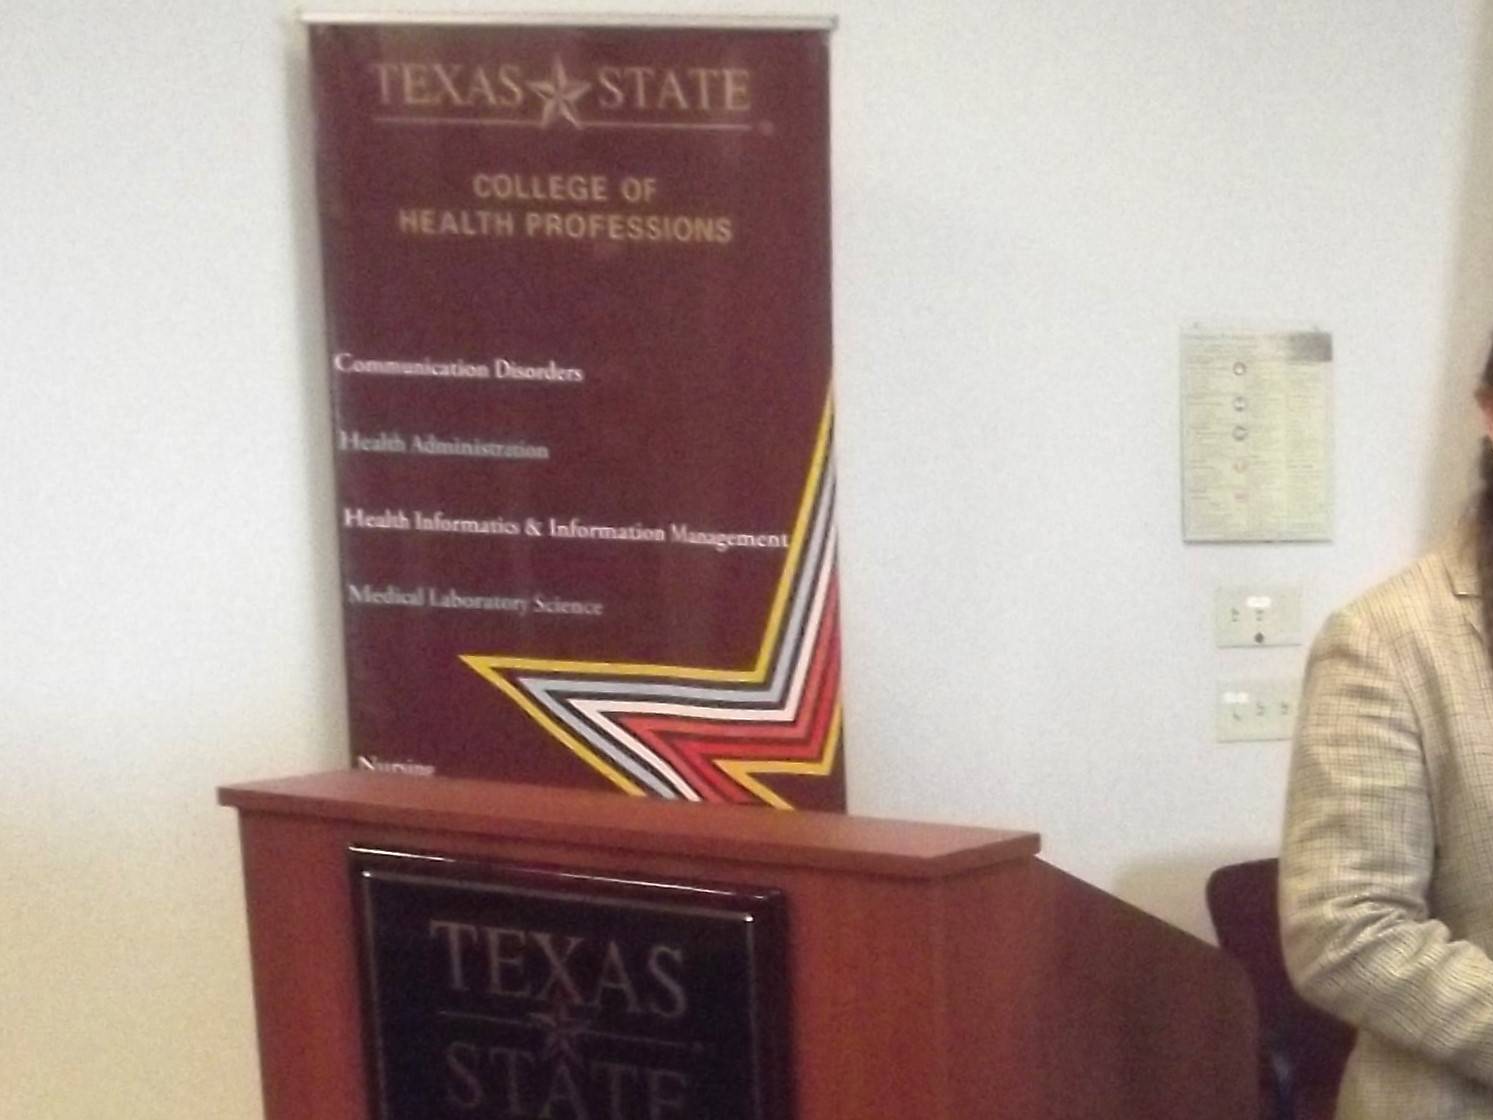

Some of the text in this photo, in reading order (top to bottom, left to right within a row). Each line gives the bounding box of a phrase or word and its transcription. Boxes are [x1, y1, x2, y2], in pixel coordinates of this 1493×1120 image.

[373, 63, 752, 111] TEXAS STATE
[473, 173, 657, 202] COLLEGE OF
[400, 208, 734, 243] HEALTH PROFESSIONS
[334, 353, 585, 382] Communication Disorders
[340, 431, 549, 459] Health Administration
[344, 508, 789, 552] Health Informatics & Information Management
[349, 584, 603, 616] Medical Laboratory Science
[430, 919, 688, 1019] TEXAS
